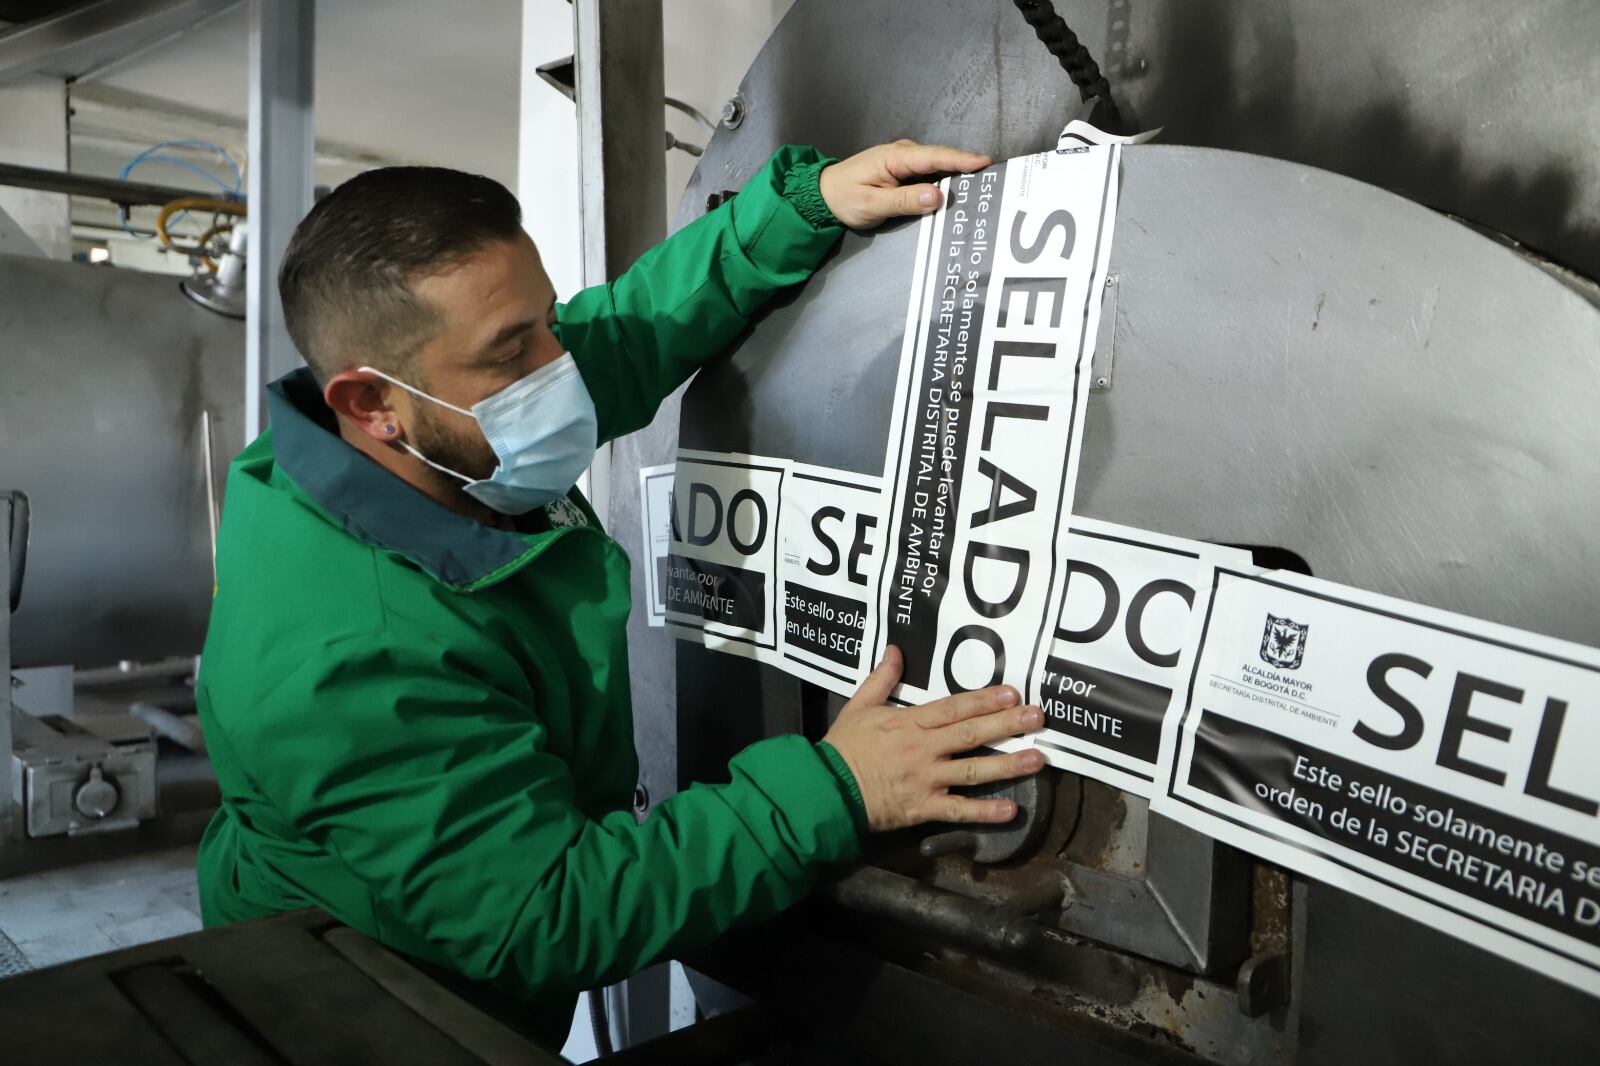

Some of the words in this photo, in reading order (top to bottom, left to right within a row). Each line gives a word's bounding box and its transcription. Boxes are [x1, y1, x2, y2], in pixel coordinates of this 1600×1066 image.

[977, 171, 998, 213] Este
[952, 209, 969, 235] de
[949, 240, 966, 257] la
[970, 219, 988, 265] sello
[931, 263, 962, 382] SECRETARIA
[953, 270, 979, 376] solamente
[950, 380, 963, 402] se
[916, 388, 943, 486] DISTRITAL
[940, 407, 960, 472] puede
[943, 208, 1077, 695] SELLADO
[911, 492, 929, 519] DE
[929, 478, 954, 559] levantar
[896, 523, 924, 625] AMBIENTE
[920, 562, 939, 597] por
[784, 590, 806, 612] Este
[807, 600, 835, 621] sello
[801, 622, 816, 642] de
[817, 627, 828, 646] la
[1057, 675, 1097, 699] por
[1242, 663, 1281, 682] ALCALDÍA
[1281, 675, 1313, 691] MAYOR
[1242, 673, 1254, 684] DE
[1254, 677, 1290, 695] BOGOTÁ
[1251, 693, 1288, 710] DISTRITAL
[1289, 705, 1300, 714] DE
[1299, 709, 1339, 728] AMBIENTE
[1293, 754, 1343, 792] Este
[1349, 778, 1407, 816] sello
[1413, 803, 1565, 873] solamente
[1255, 781, 1324, 821] orden
[1329, 806, 1361, 836] de
[1367, 818, 1389, 847] la
[1396, 831, 1566, 916] SECRETARIA
